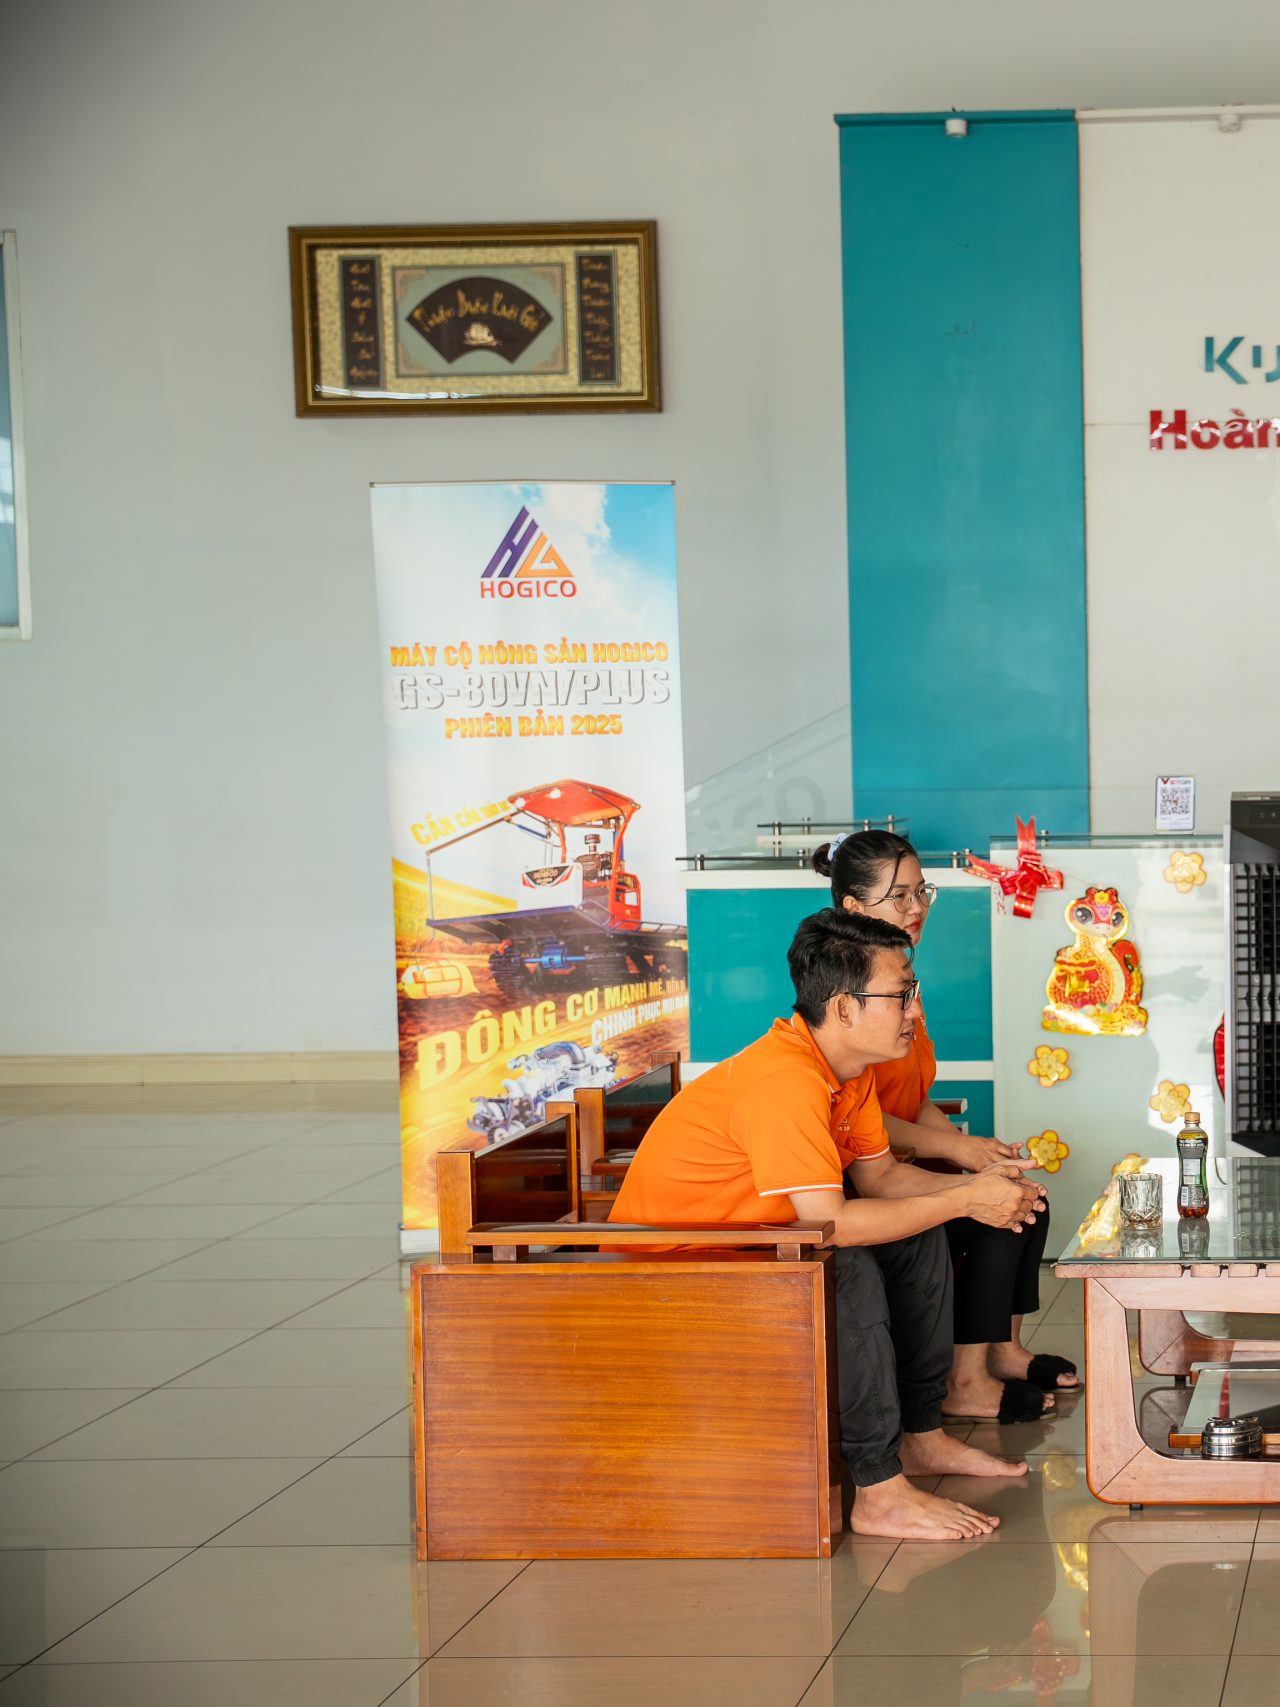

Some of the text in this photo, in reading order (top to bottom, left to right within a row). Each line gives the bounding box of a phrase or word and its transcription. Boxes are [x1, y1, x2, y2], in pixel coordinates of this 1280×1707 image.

[480, 579, 577, 599] HOGICO
[390, 637, 669, 670] MÁY CỘ NÔNG SẢN HOGICO
[393, 668, 671, 710] GS-80VN/PLUS
[445, 709, 624, 739] PHIÊN BẢN 2025
[566, 987, 599, 1022] CƠ
[604, 980, 648, 1011] MẠNH
